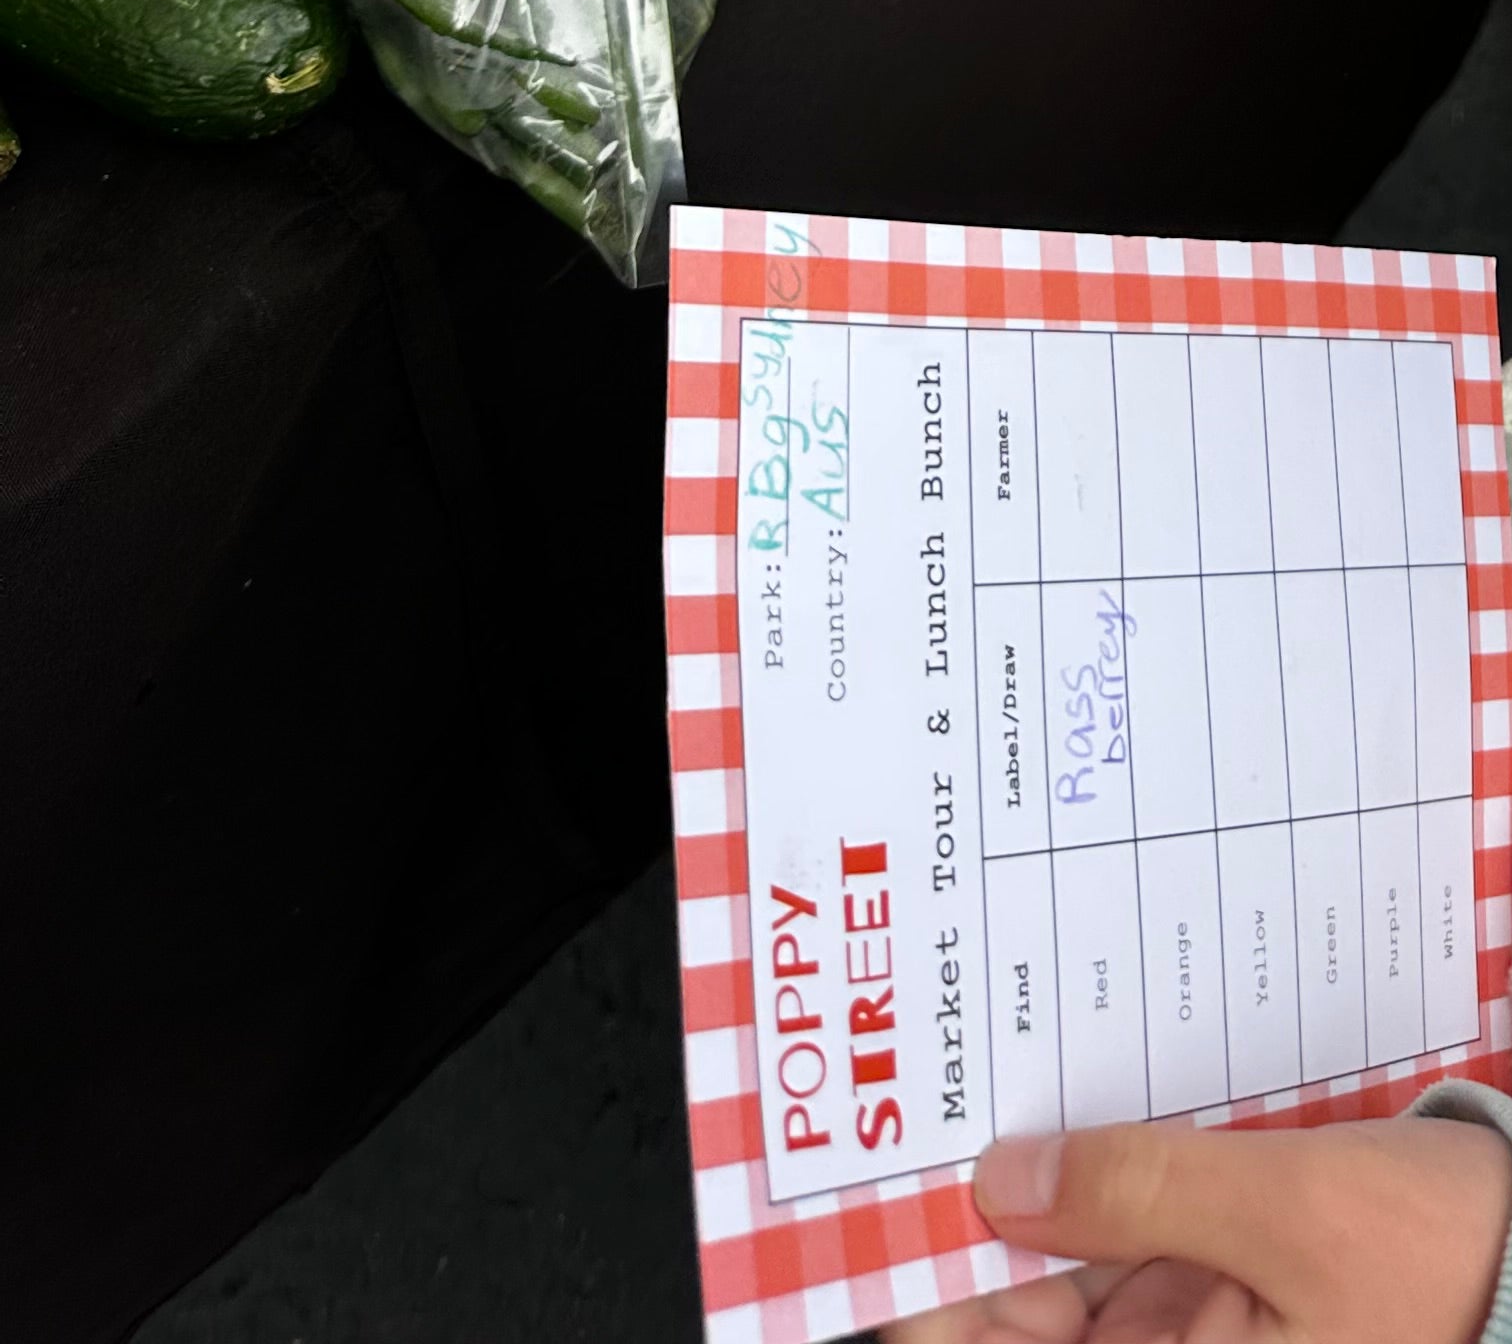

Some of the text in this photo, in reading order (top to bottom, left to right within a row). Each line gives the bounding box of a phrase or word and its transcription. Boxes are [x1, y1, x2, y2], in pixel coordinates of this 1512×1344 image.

[765, 561, 785, 670] Park:
[827, 526, 848, 703] Country:
[917, 361, 967, 1123] Market Tour & Lunch Bunch
[996, 409, 1033, 1035] Find Label/Draw Farmer
[1178, 920, 1194, 1022] Orange
[1255, 909, 1270, 1009] Yellow
[1325, 905, 1339, 986] Green
[1387, 886, 1401, 980] Purple
[1441, 884, 1456, 962] White
[769, 883, 832, 1153] POPPY
[840, 835, 904, 1152] STREET
[1094, 957, 1112, 1011] Red
